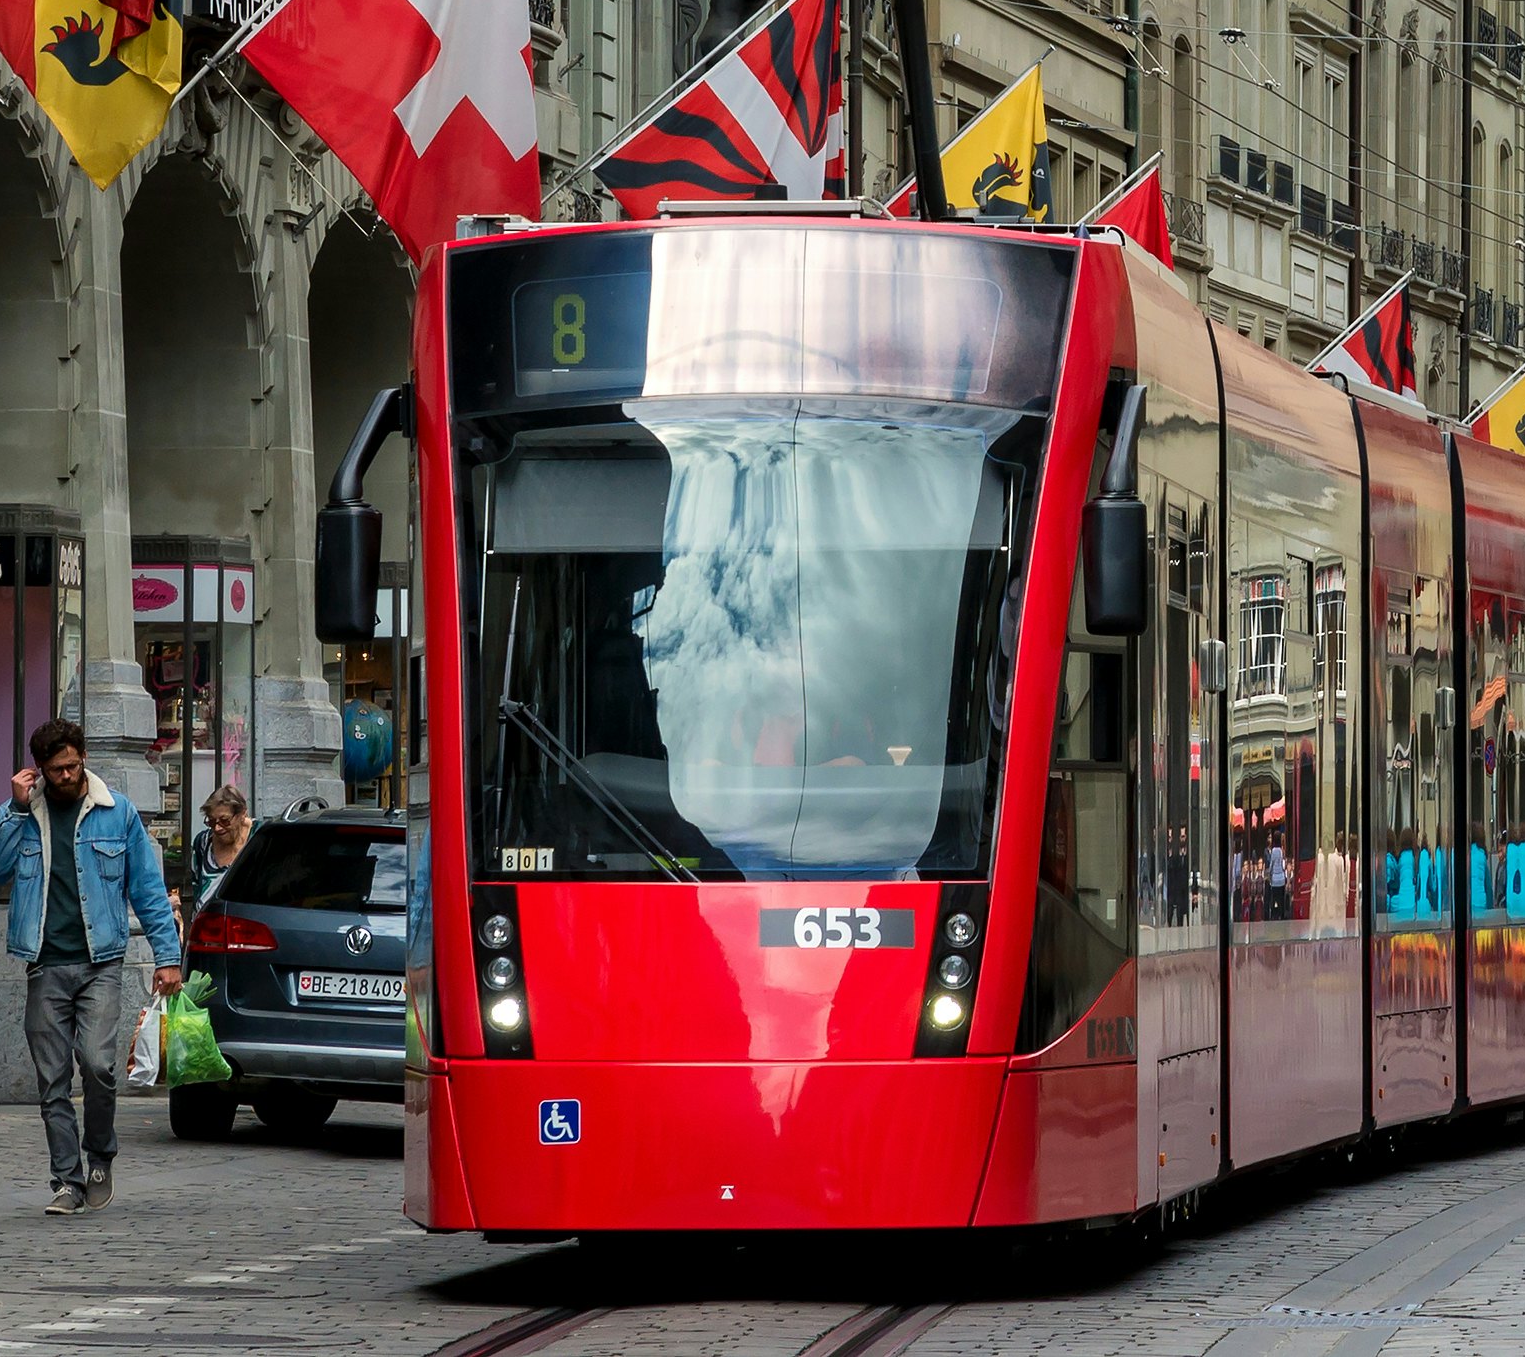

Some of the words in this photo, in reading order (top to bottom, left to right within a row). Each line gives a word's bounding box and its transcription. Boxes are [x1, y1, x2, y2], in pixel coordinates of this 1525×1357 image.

[553, 294, 585, 364] 8
[505, 854, 550, 869] 801
[793, 907, 882, 949] 653
